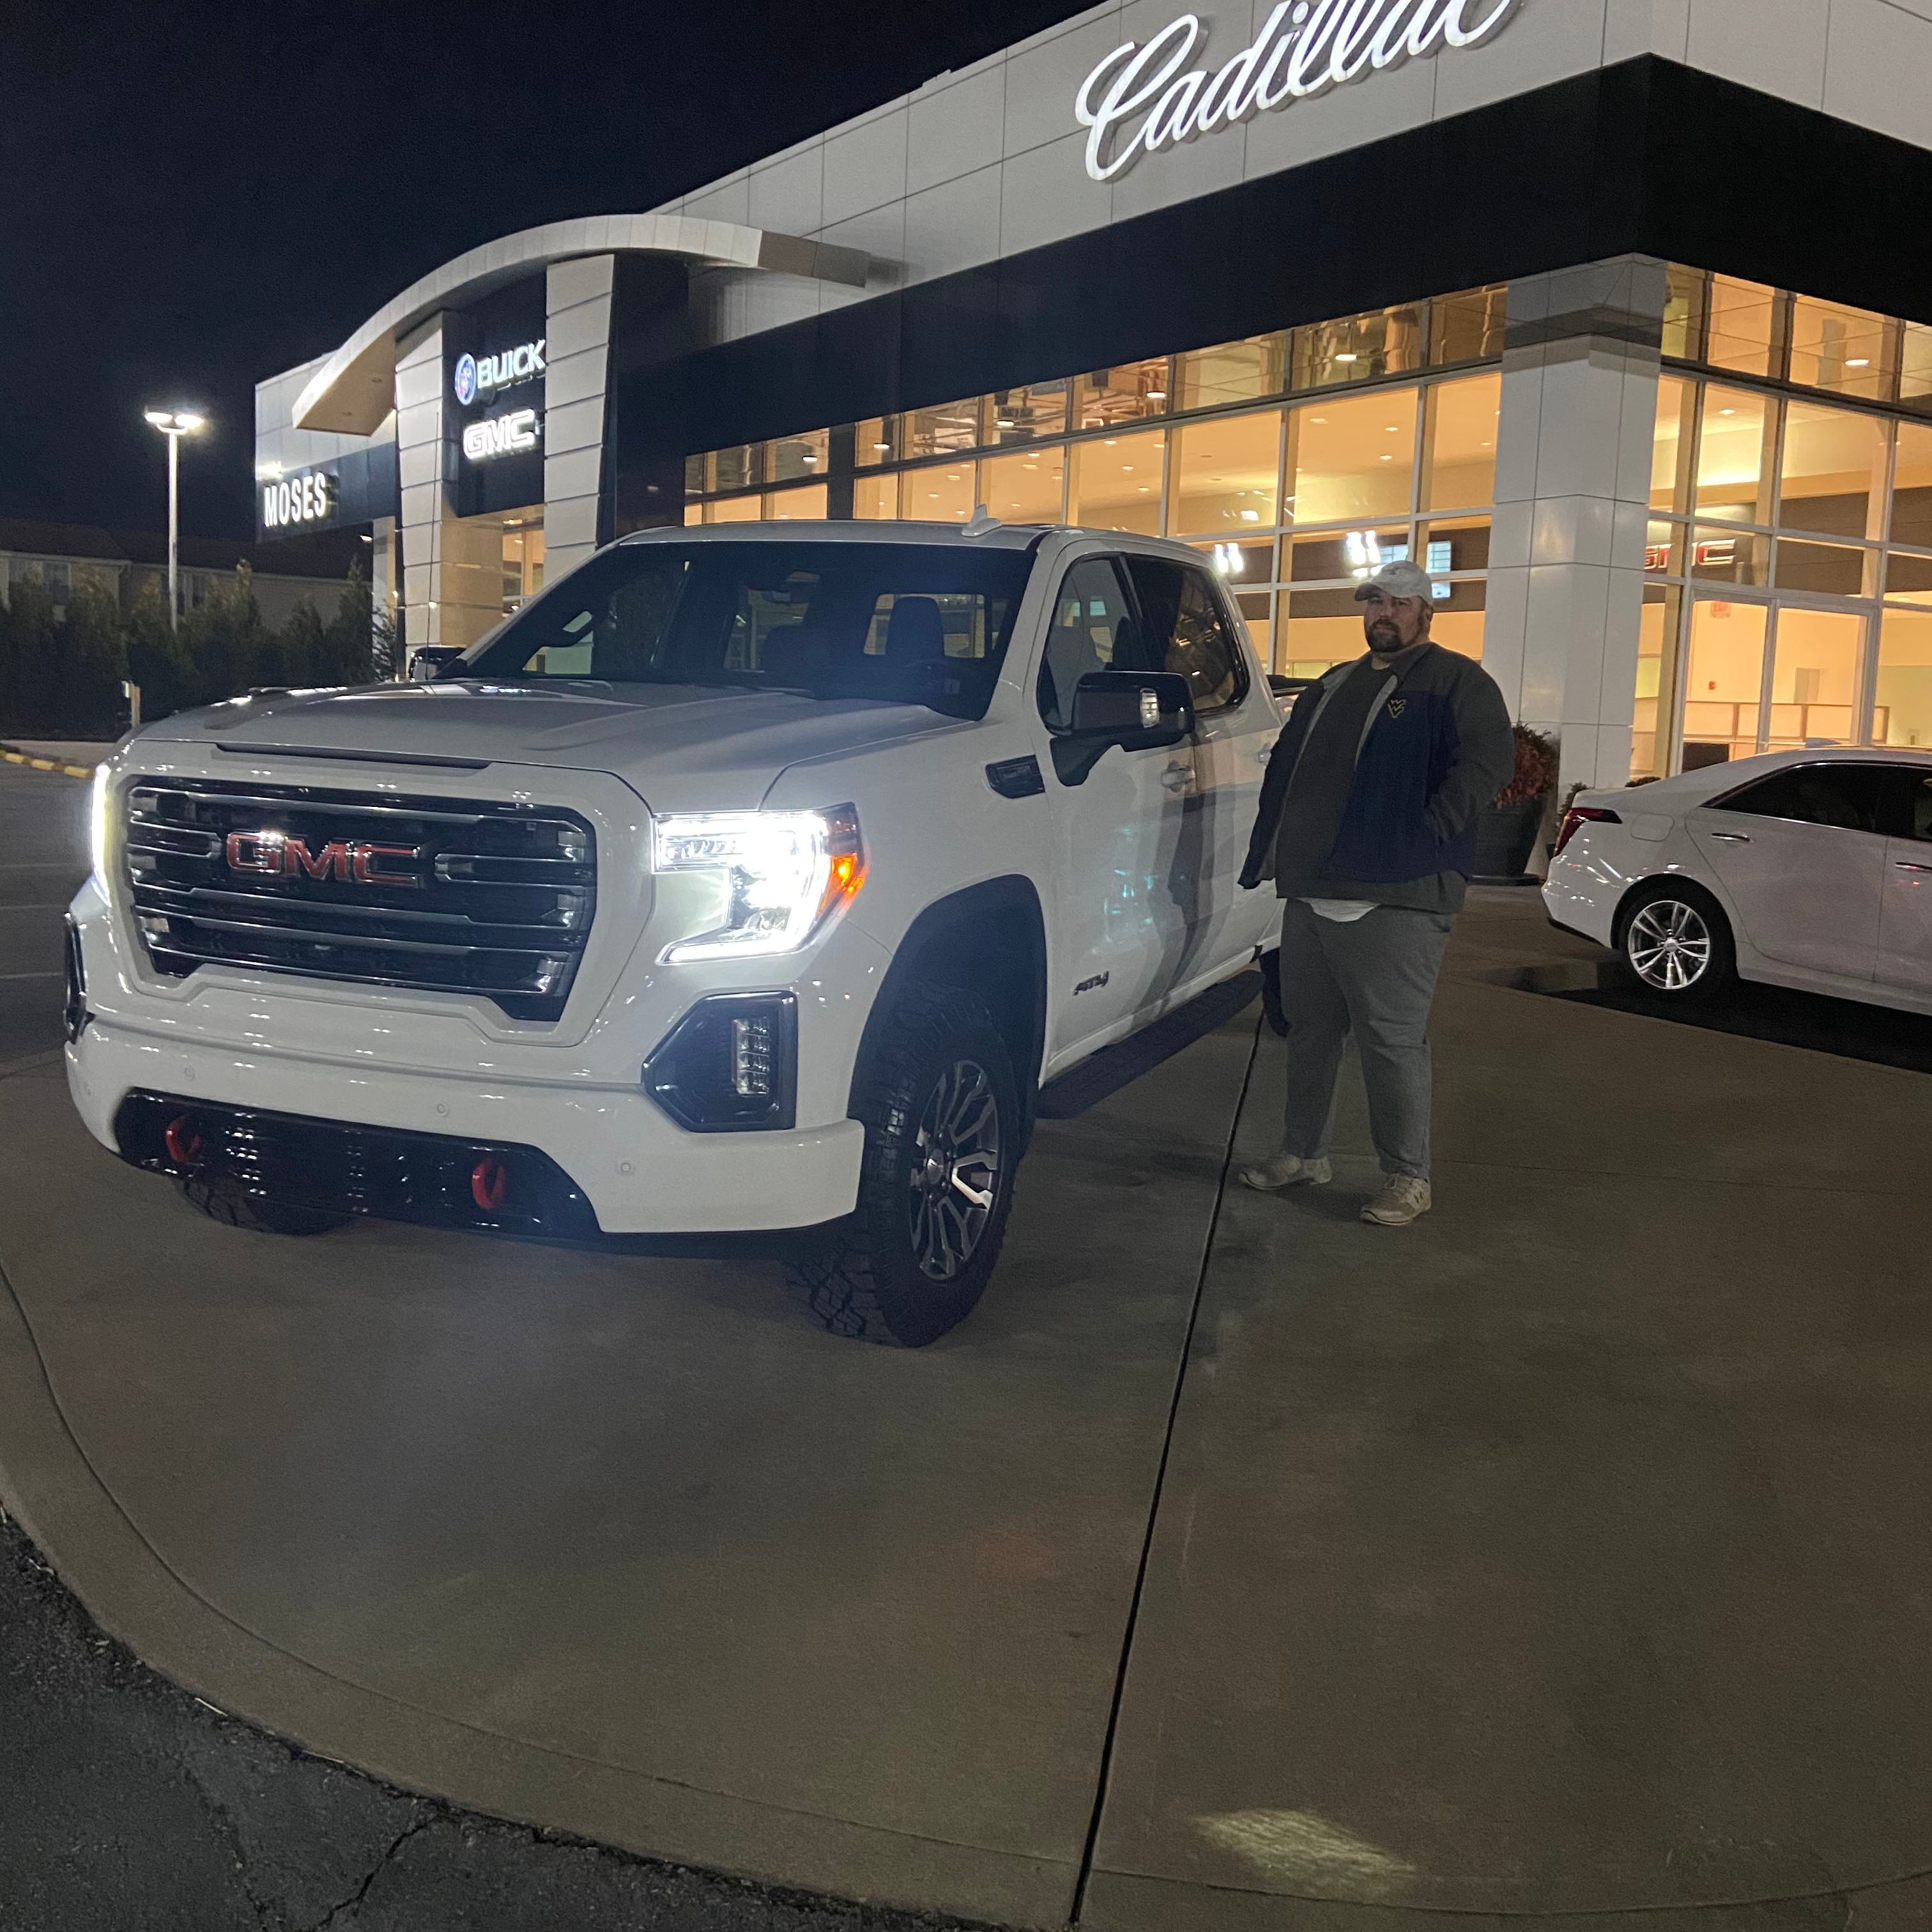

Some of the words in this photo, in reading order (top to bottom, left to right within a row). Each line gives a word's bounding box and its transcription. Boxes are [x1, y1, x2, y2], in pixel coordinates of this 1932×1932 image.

[477, 339, 546, 389] BUICK
[463, 408, 535, 460] GMC
[264, 471, 326, 527] MOSES
[227, 831, 420, 887] GMC
